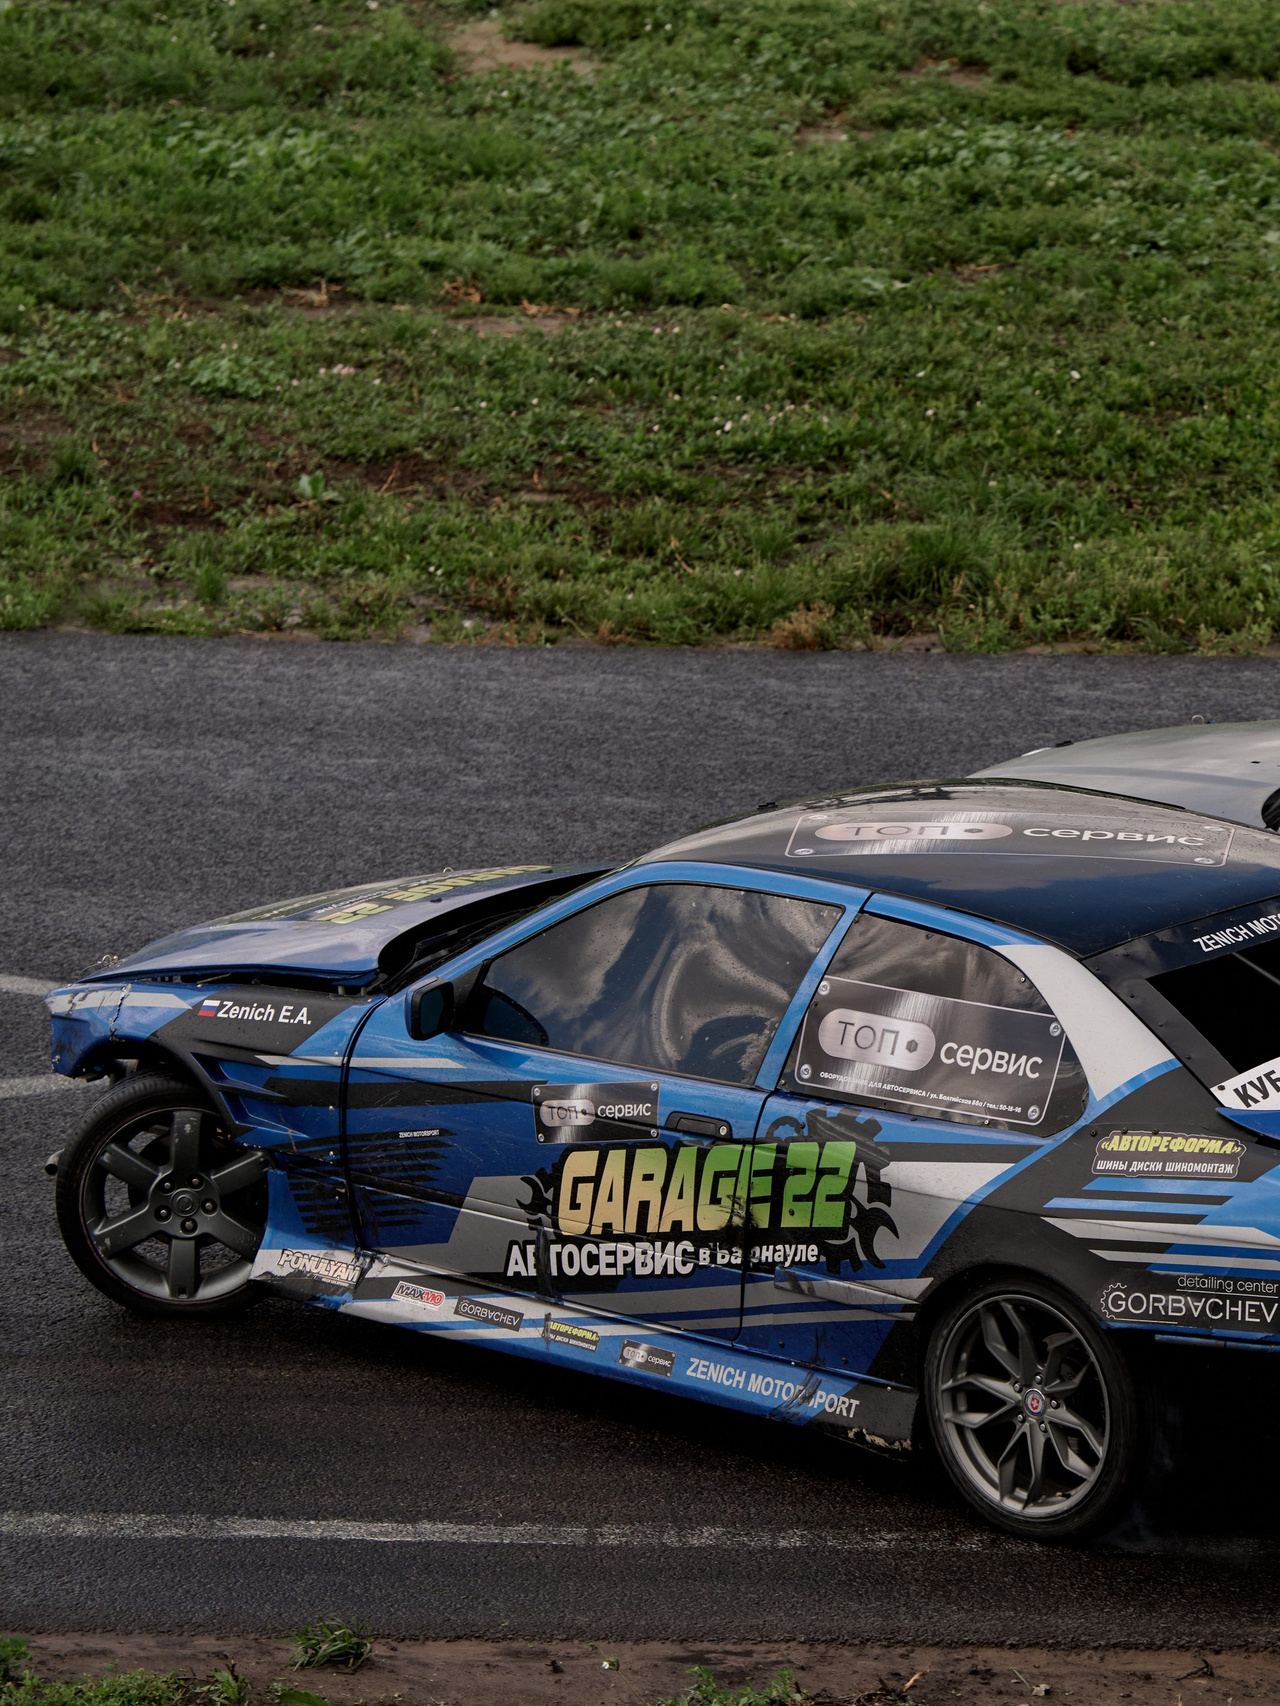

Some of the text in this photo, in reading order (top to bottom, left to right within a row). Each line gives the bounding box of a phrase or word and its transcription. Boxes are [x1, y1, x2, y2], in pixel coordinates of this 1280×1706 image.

[846, 826, 1205, 847] ТОП сервис
[1192, 922, 1255, 952] ZENICH
[217, 1000, 312, 1025] Zenich E.A.
[838, 1020, 1043, 1079] ТОП сервис
[819, 1071, 868, 1086] ОБОРУДОВАНИЕ
[868, 1081, 882, 1089] ДЛЯ
[882, 1083, 926, 1097] АВТОСЕРВИСА
[939, 1093, 971, 1105] Балтийская
[548, 1101, 652, 1121] ТОП сервис
[1101, 1135, 1242, 1154] «АВТОРЕФОРМА»
[558, 1141, 856, 1236] GARAGE 22
[277, 1249, 361, 1282] PONULYAM
[698, 1247, 711, 1266] в
[396, 1283, 444, 1305] MAXMO
[1177, 1275, 1279, 1293] detailing center
[461, 1302, 520, 1326] GORBACHEV
[1108, 1291, 1279, 1323] GORBACHEV
[626, 1349, 672, 1368] ТОП сервис
[686, 1357, 746, 1390] ZENICH
